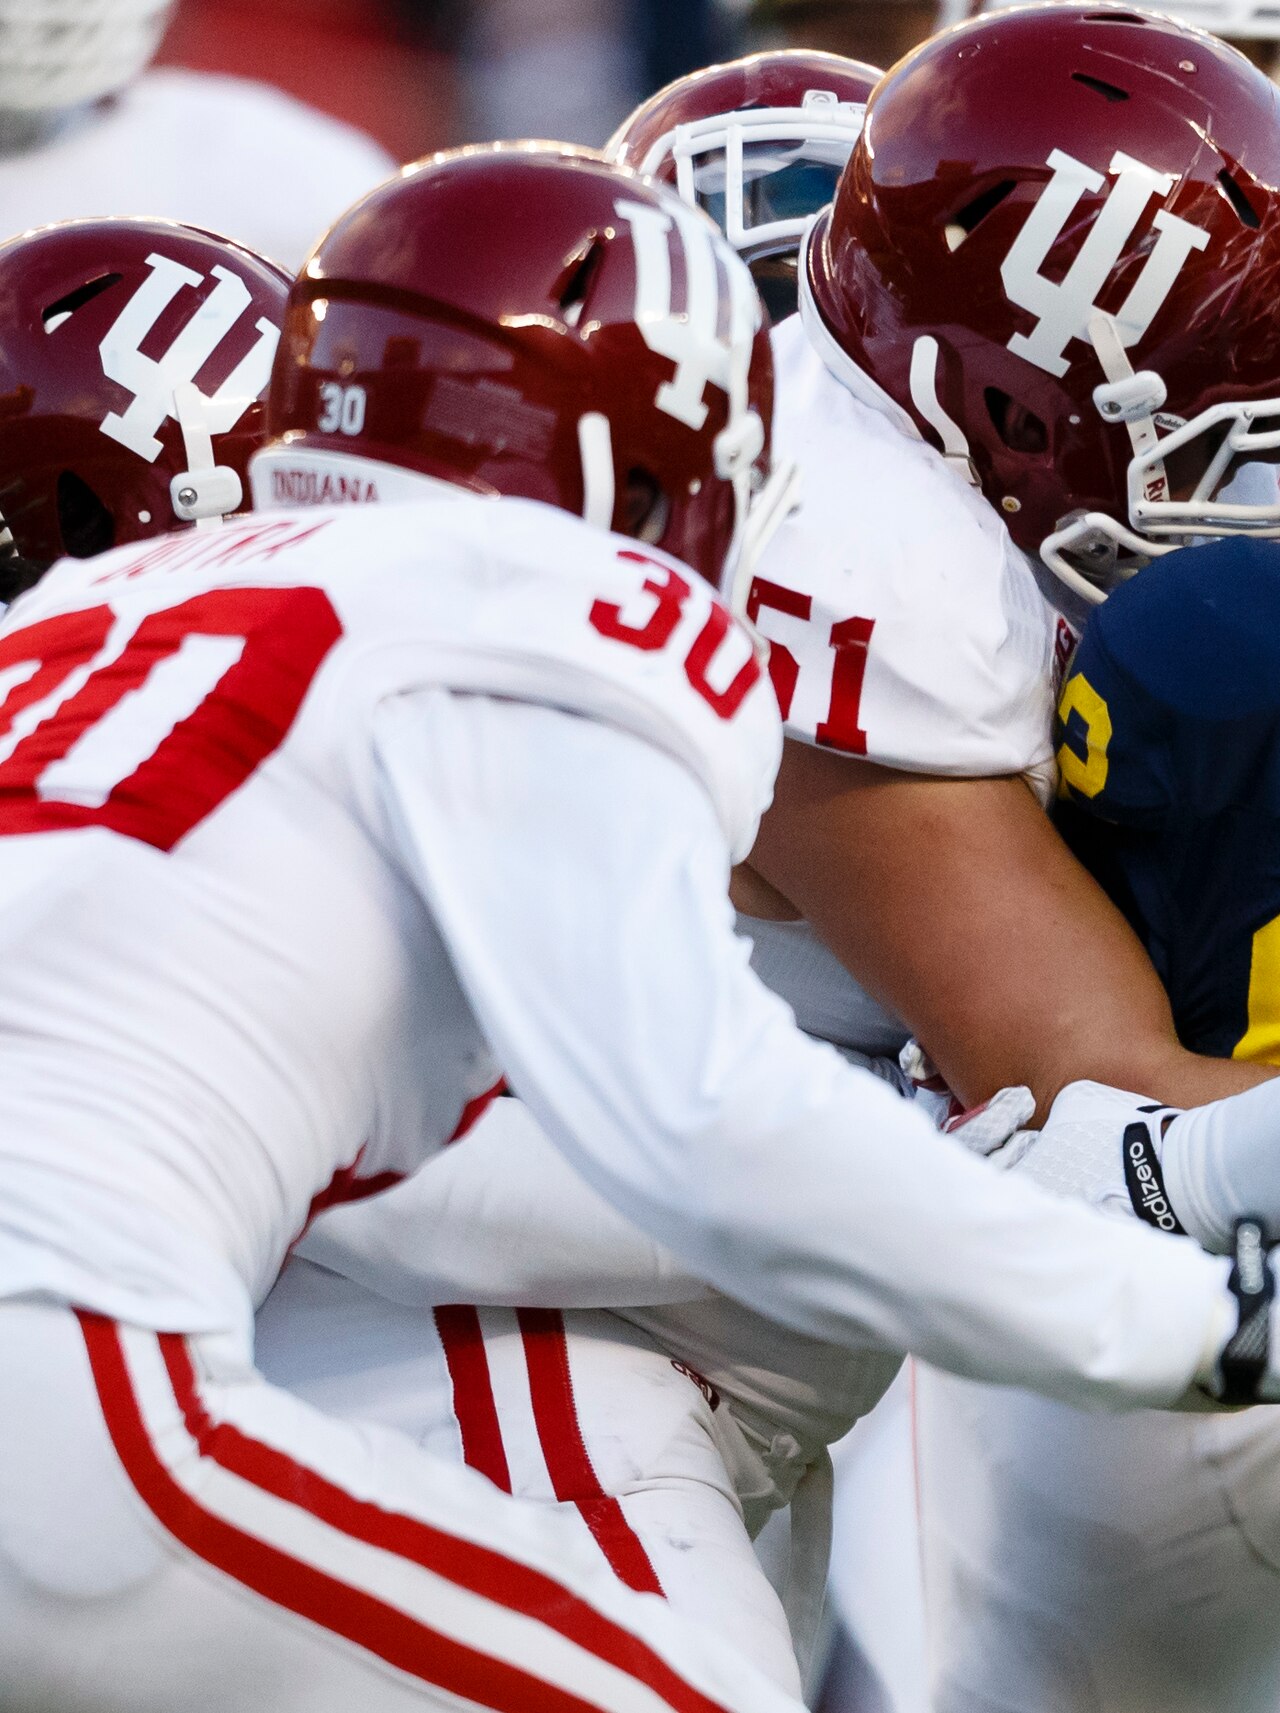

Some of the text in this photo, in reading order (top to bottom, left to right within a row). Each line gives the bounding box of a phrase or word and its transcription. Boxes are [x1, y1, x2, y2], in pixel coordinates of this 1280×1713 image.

[318, 382, 367, 436] 30
[589, 551, 760, 721] 30
[747, 576, 876, 756] 51
[1129, 1141, 1176, 1231] adizero
